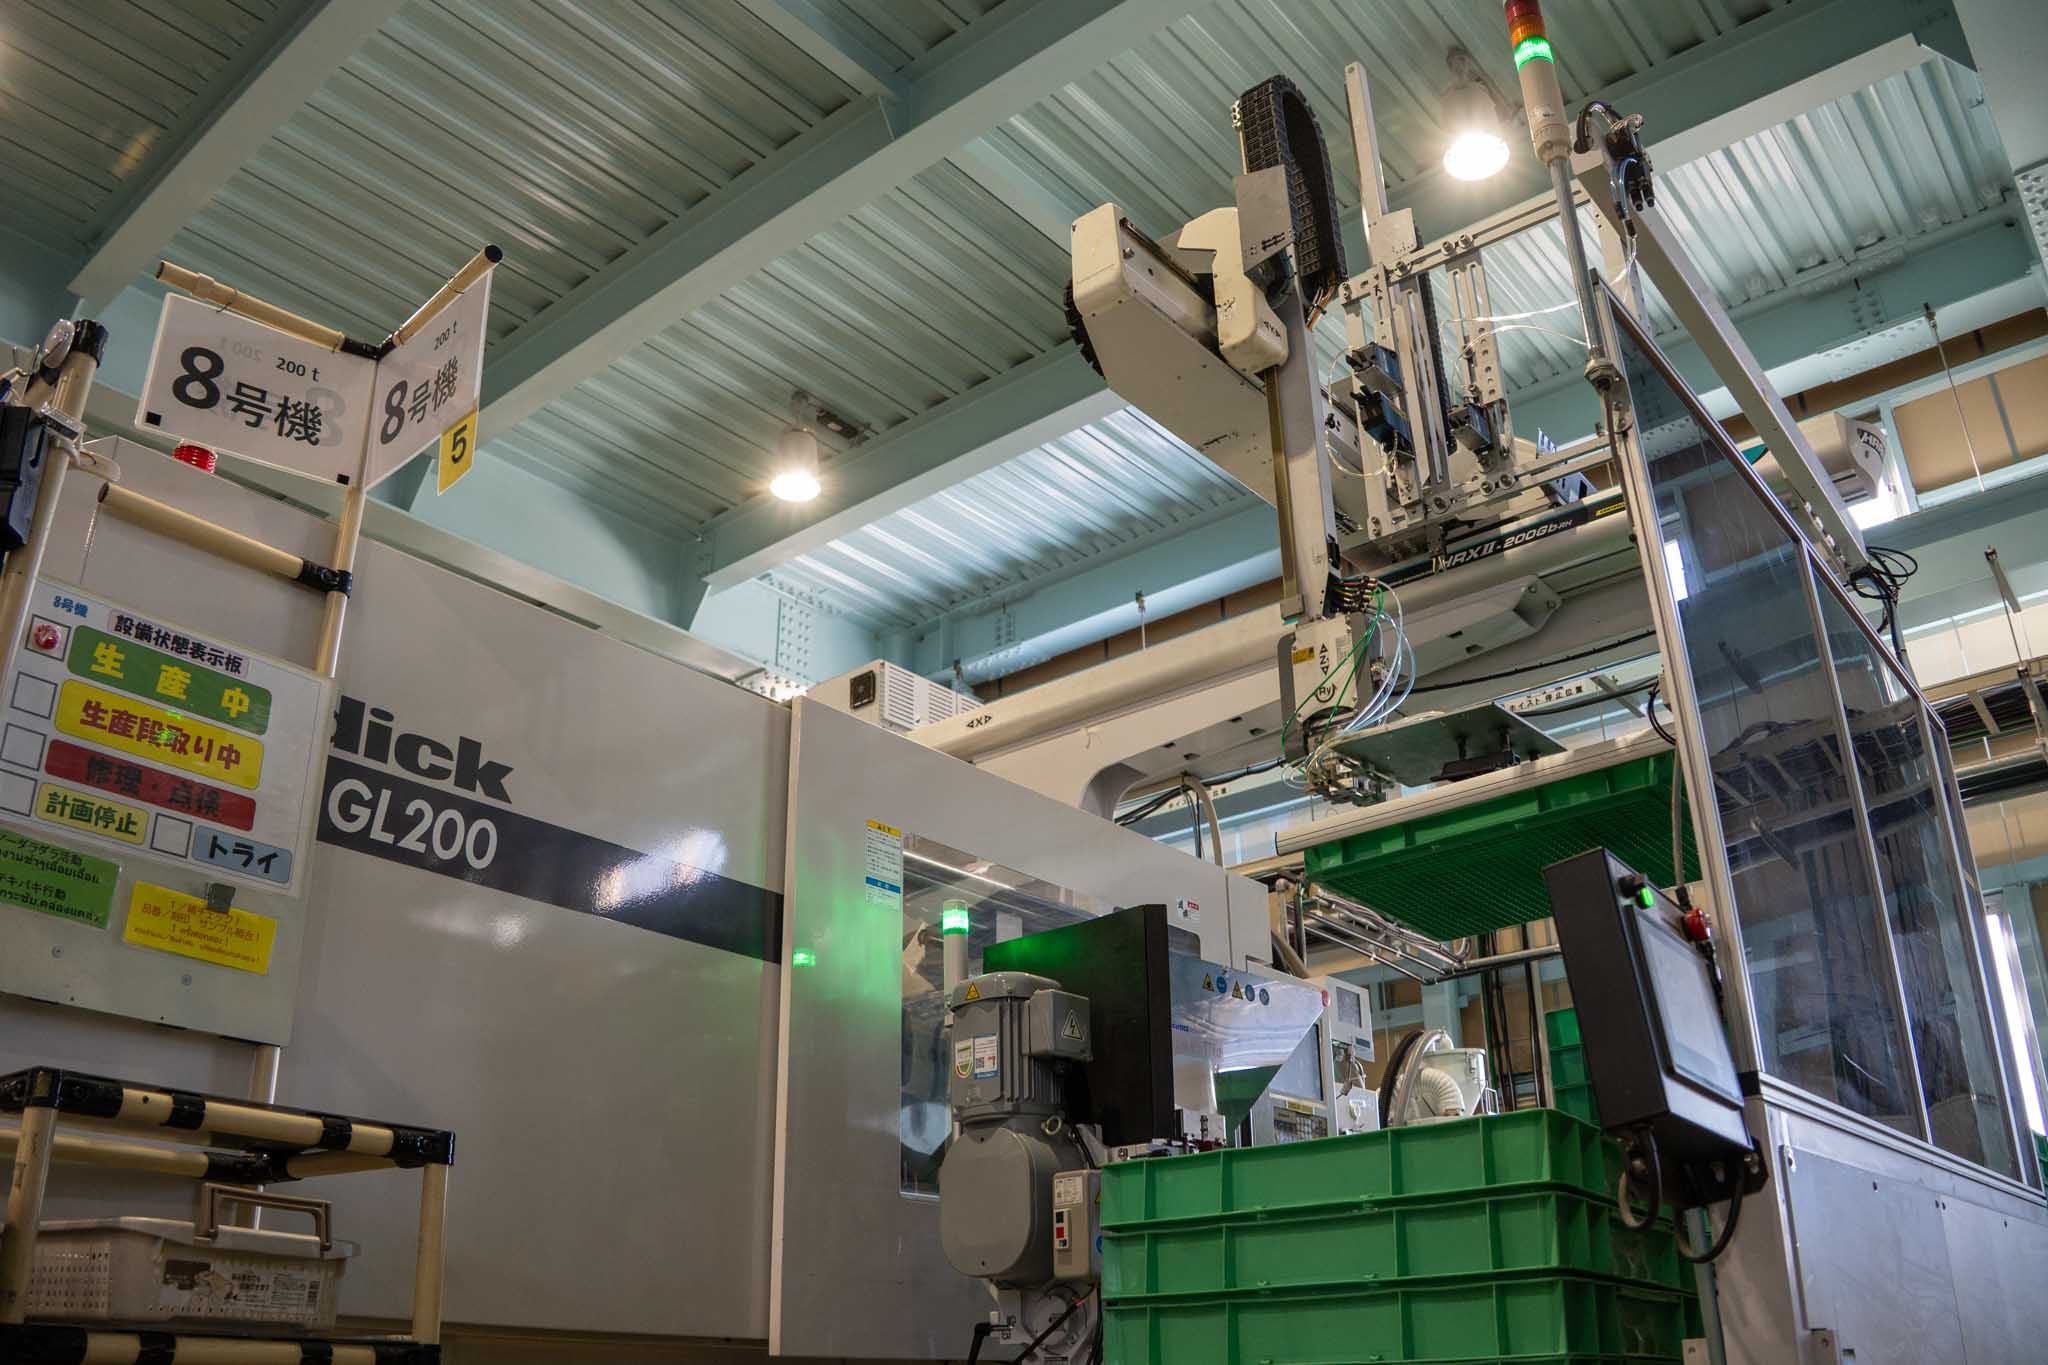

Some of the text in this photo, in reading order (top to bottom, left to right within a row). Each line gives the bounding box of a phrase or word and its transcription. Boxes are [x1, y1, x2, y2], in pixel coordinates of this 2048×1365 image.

[434, 328, 450, 351] 200
[275, 357, 321, 382] 200 t
[172, 346, 323, 447] 8号機
[380, 355, 459, 444] 8号機
[451, 424, 469, 464] 5
[53, 595, 89, 618] 8号機
[113, 614, 244, 675] 設備状態表示板
[91, 641, 250, 719] 生産中
[80, 700, 241, 770] 生産段取り中
[45, 791, 138, 837] 計画停止
[328, 778, 498, 870] GL200
[208, 835, 279, 874] トライ
